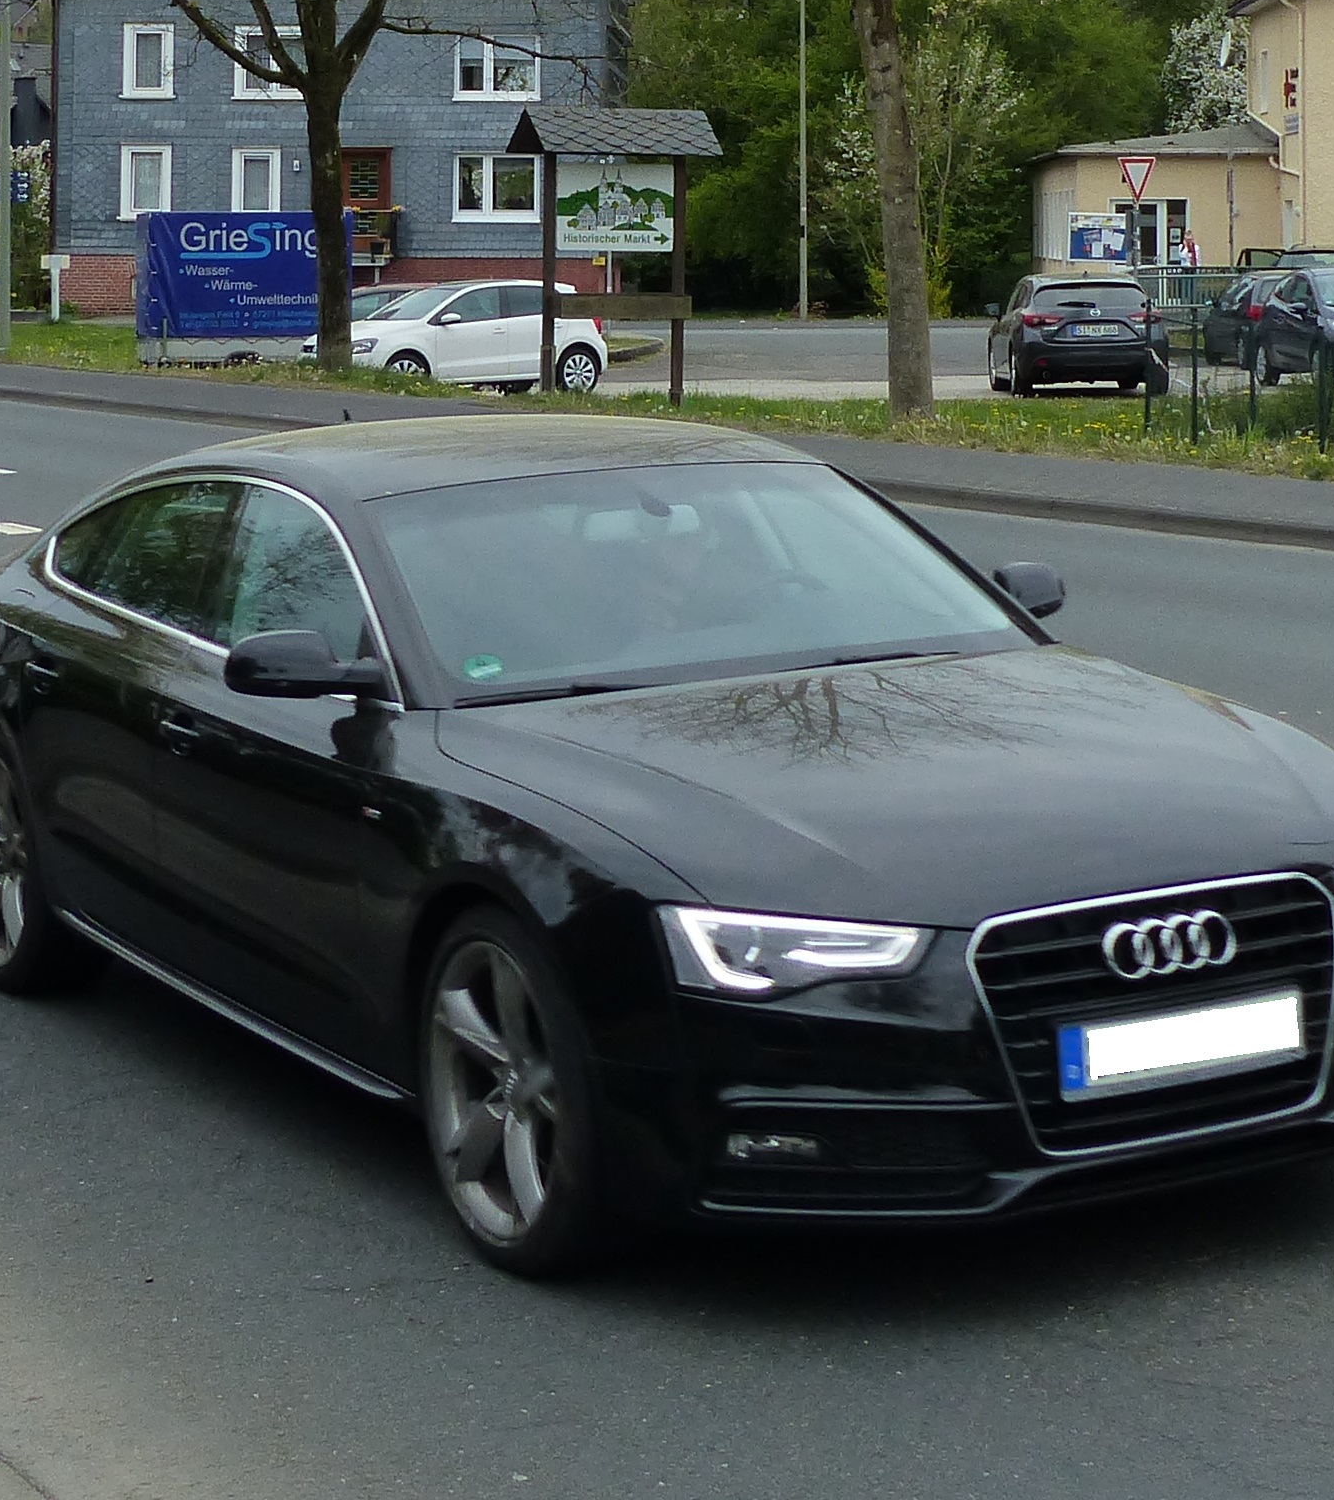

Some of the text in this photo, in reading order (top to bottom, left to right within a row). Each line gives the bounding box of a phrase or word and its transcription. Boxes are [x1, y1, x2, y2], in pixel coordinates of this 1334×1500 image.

[563, 233, 651, 244] Historischer Markt
[185, 264, 234, 277] Wasser-
[210, 280, 259, 291] Wärme-
